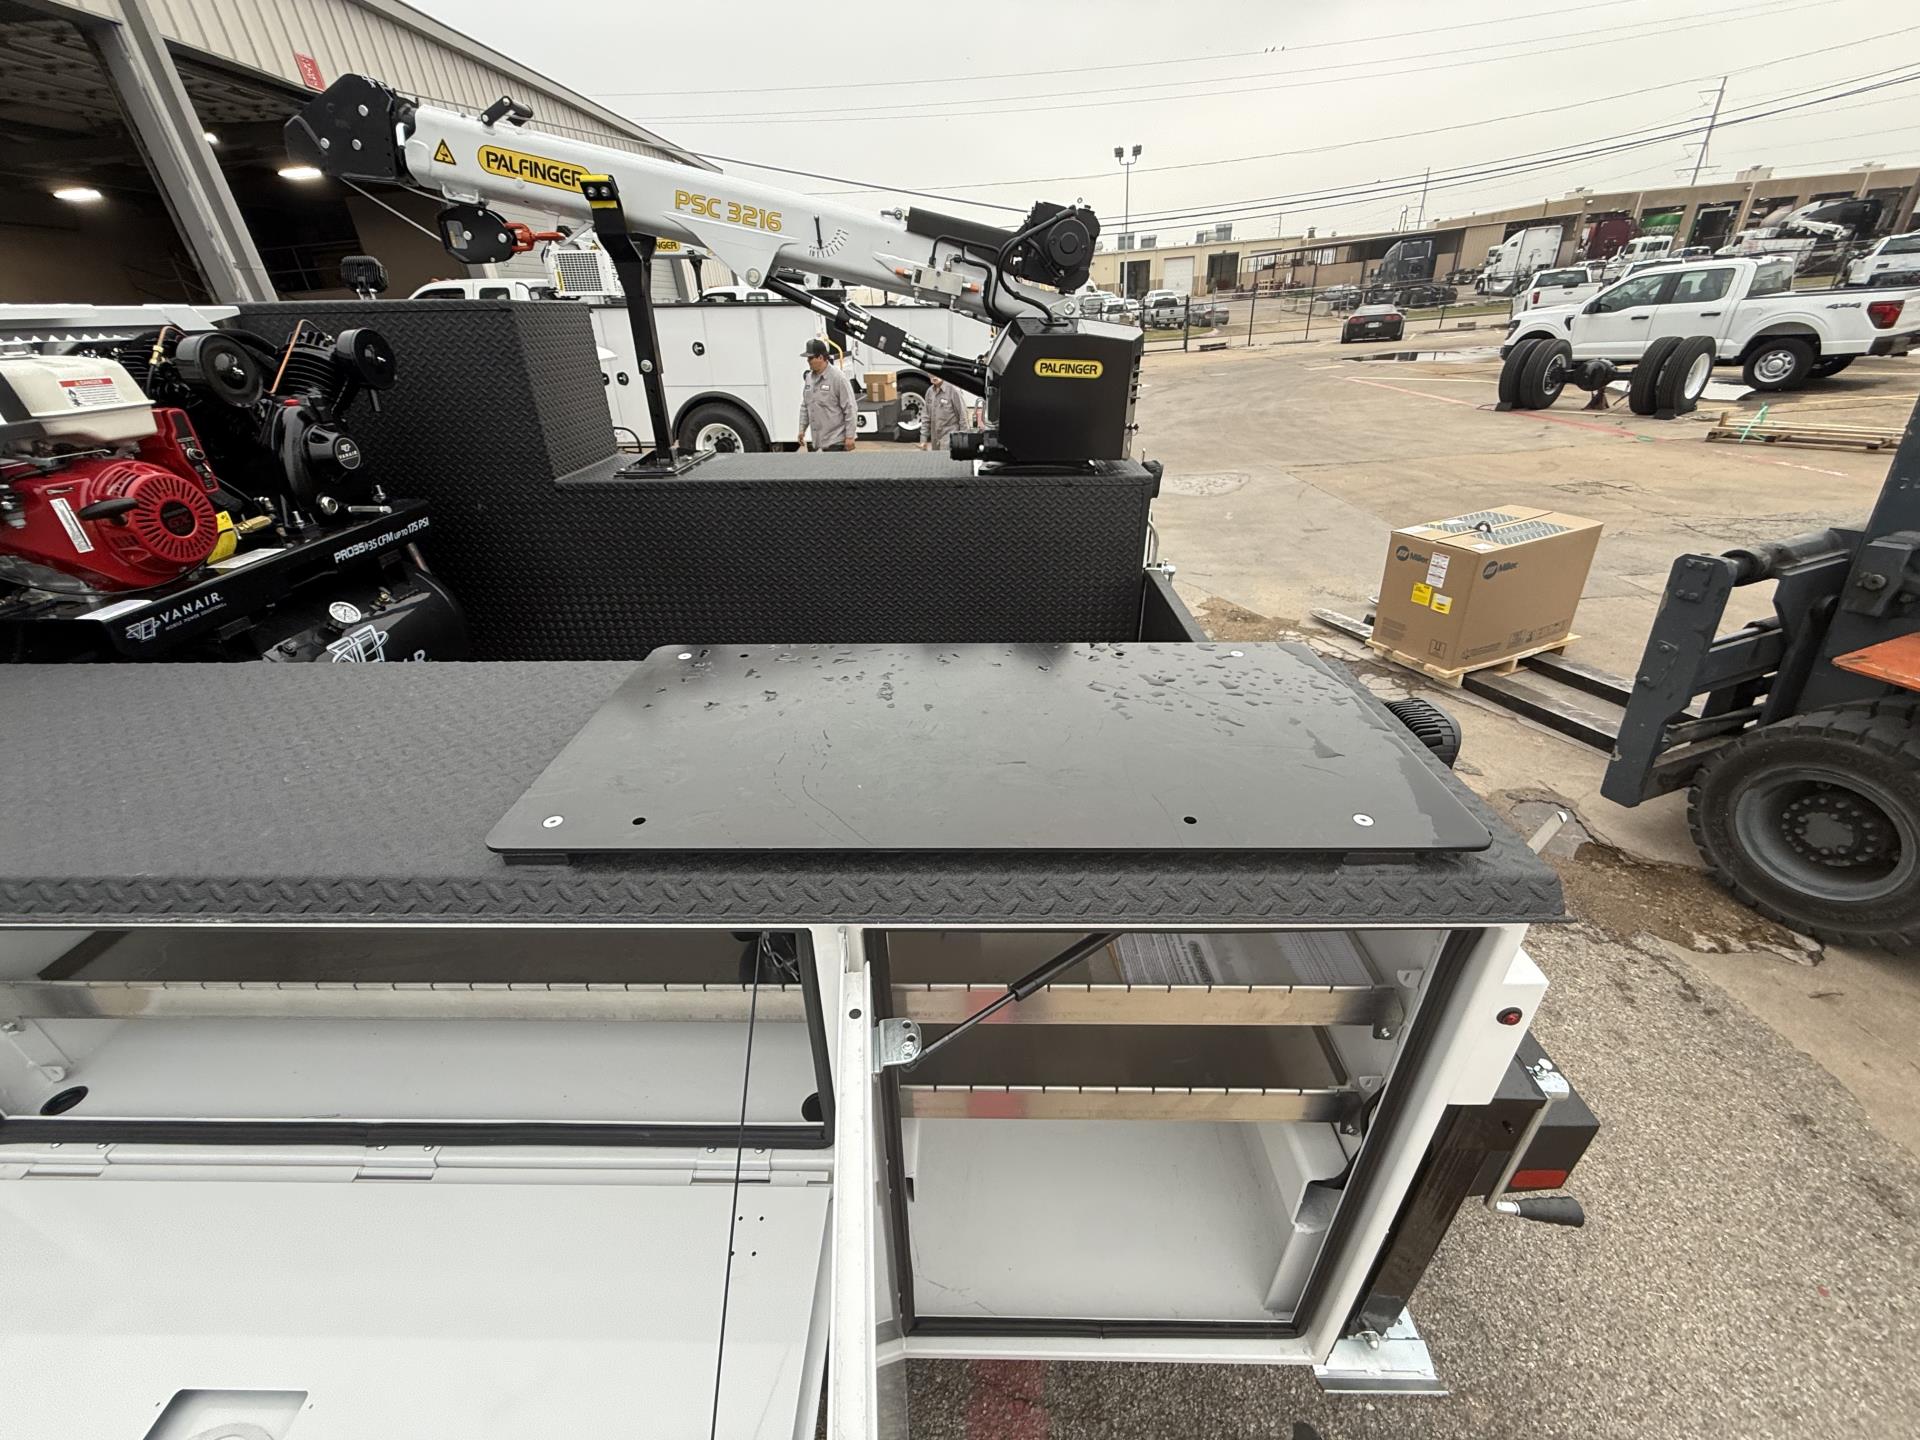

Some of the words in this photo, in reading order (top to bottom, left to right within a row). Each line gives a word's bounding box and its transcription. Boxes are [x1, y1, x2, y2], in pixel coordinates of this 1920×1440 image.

[674, 189, 721, 219] PSC
[727, 201, 783, 232] 3216
[1039, 362, 1098, 375] PALFINGER
[333, 541, 366, 564] PRO35
[368, 538, 378, 551] 35
[377, 531, 394, 547] CFM
[407, 521, 419, 534] 175
[418, 516, 430, 529] PSI
[160, 592, 221, 624] VANAIR
